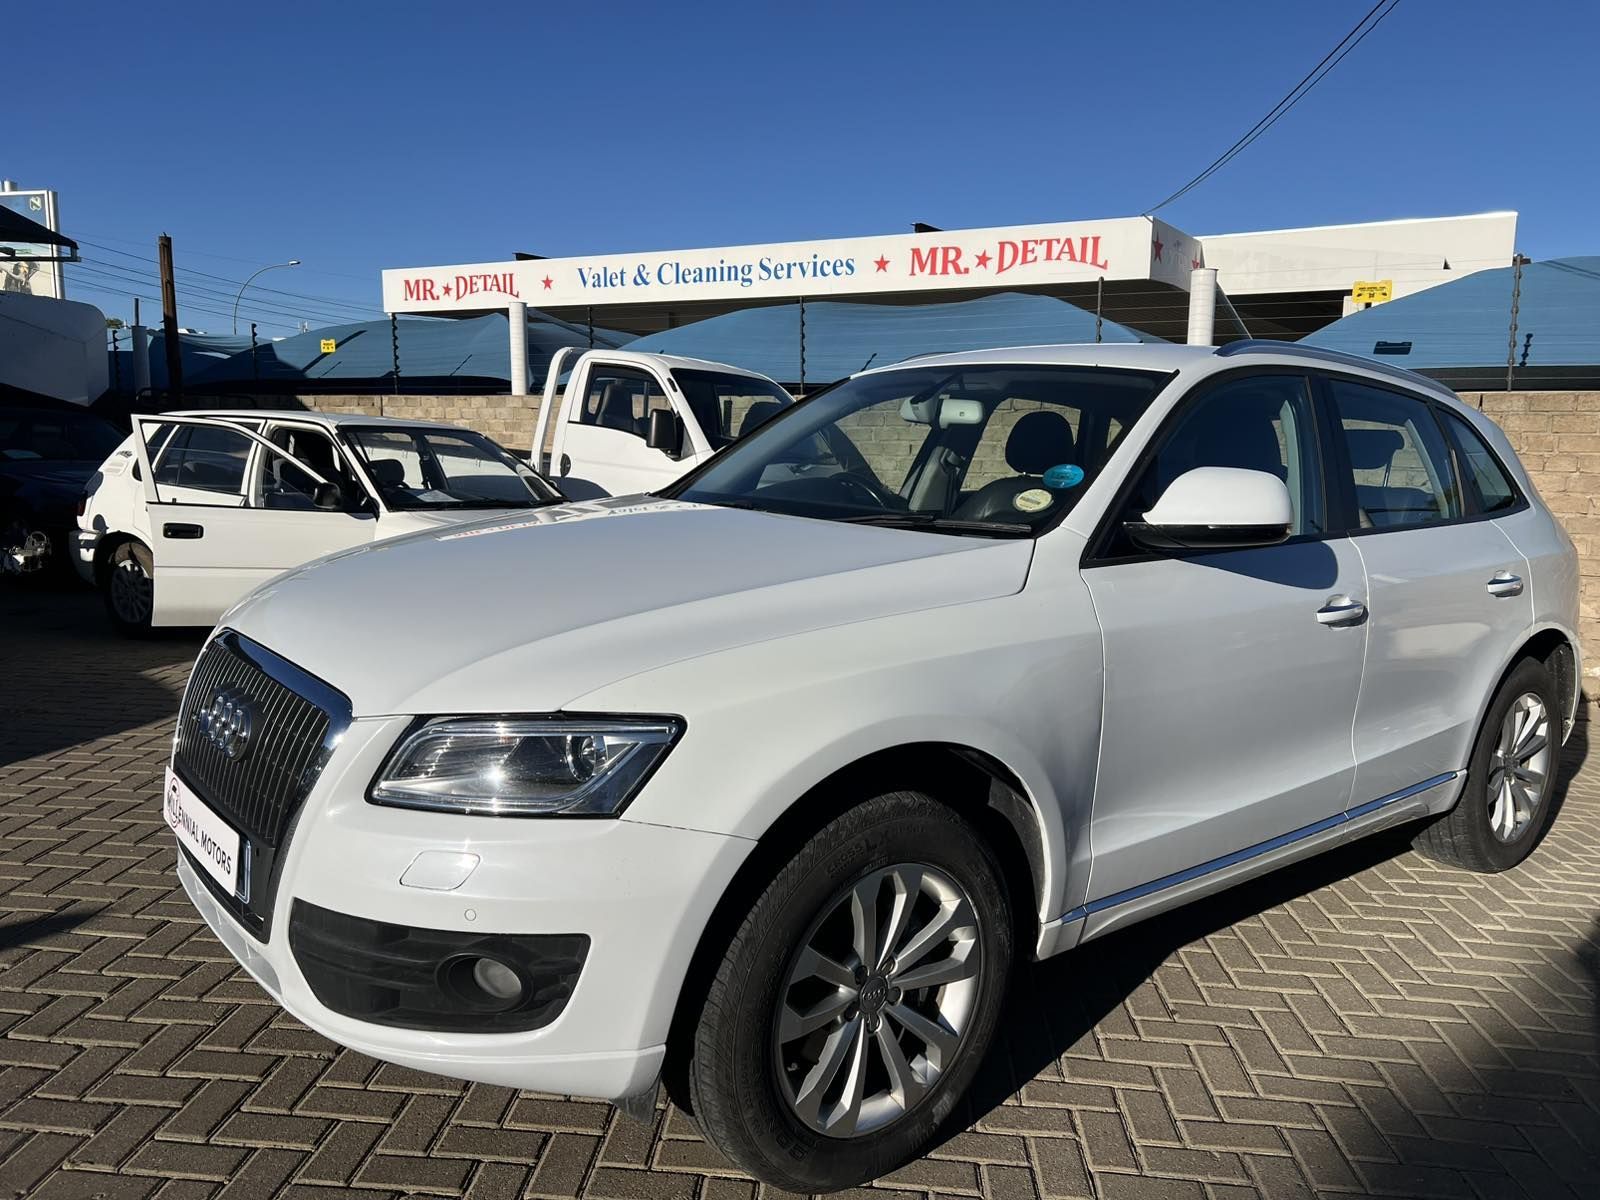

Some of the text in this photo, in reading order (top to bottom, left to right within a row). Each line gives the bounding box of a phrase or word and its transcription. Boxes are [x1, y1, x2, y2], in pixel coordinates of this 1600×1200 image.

[577, 253, 856, 289] Valet & Cleaning Services
[908, 235, 1108, 276] MR. DETAIL
[404, 273, 519, 301] MR. DETAIL
[200, 829, 232, 875] MOTORS
